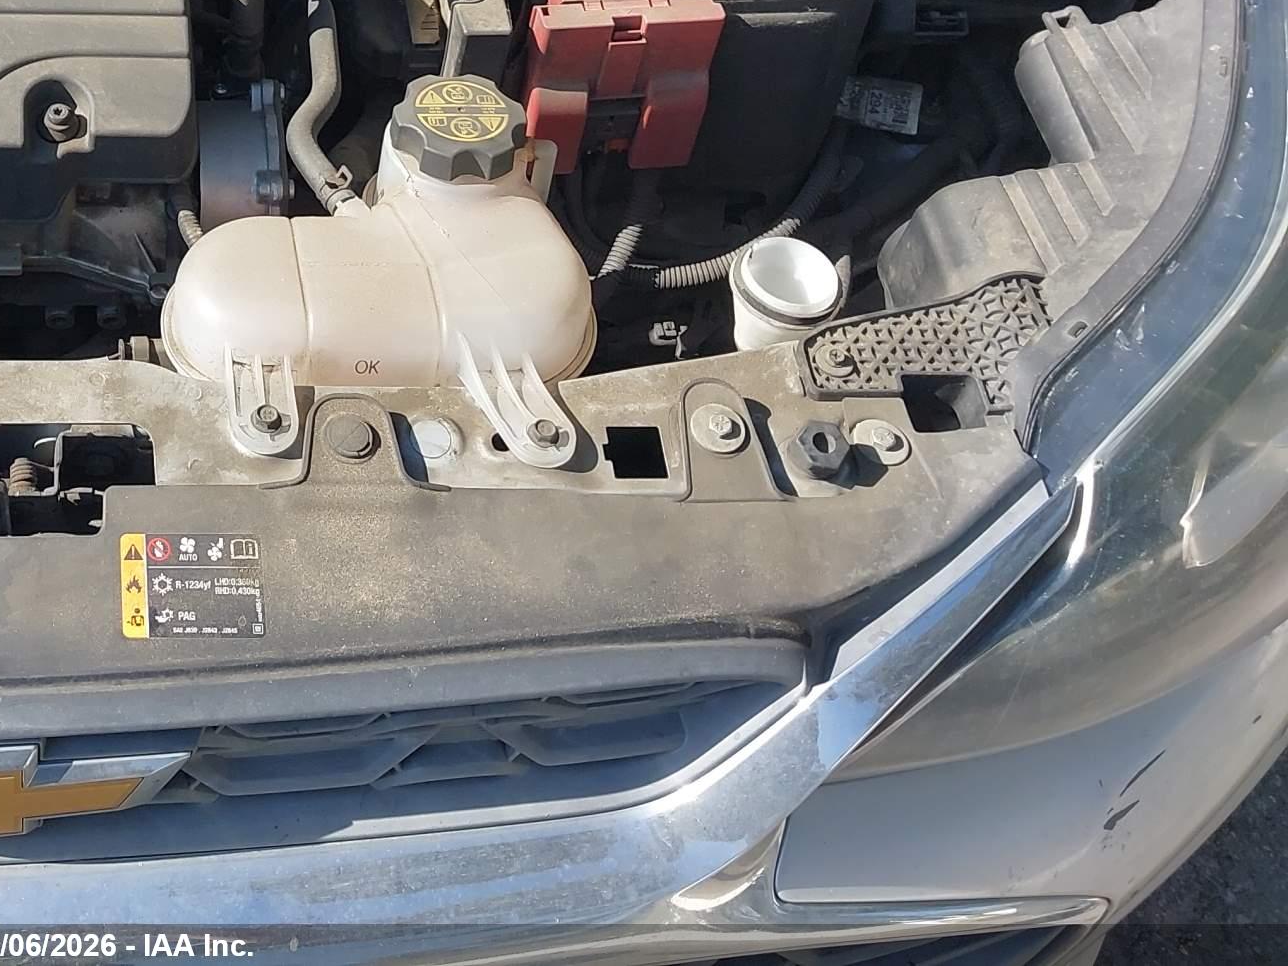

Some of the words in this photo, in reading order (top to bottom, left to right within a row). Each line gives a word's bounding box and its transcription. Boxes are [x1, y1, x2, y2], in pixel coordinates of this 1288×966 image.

[354, 360, 380, 374] OK
[178, 553, 198, 562] AUTO
[175, 580, 212, 591] R-1234yf
[177, 611, 196, 621] PAG
